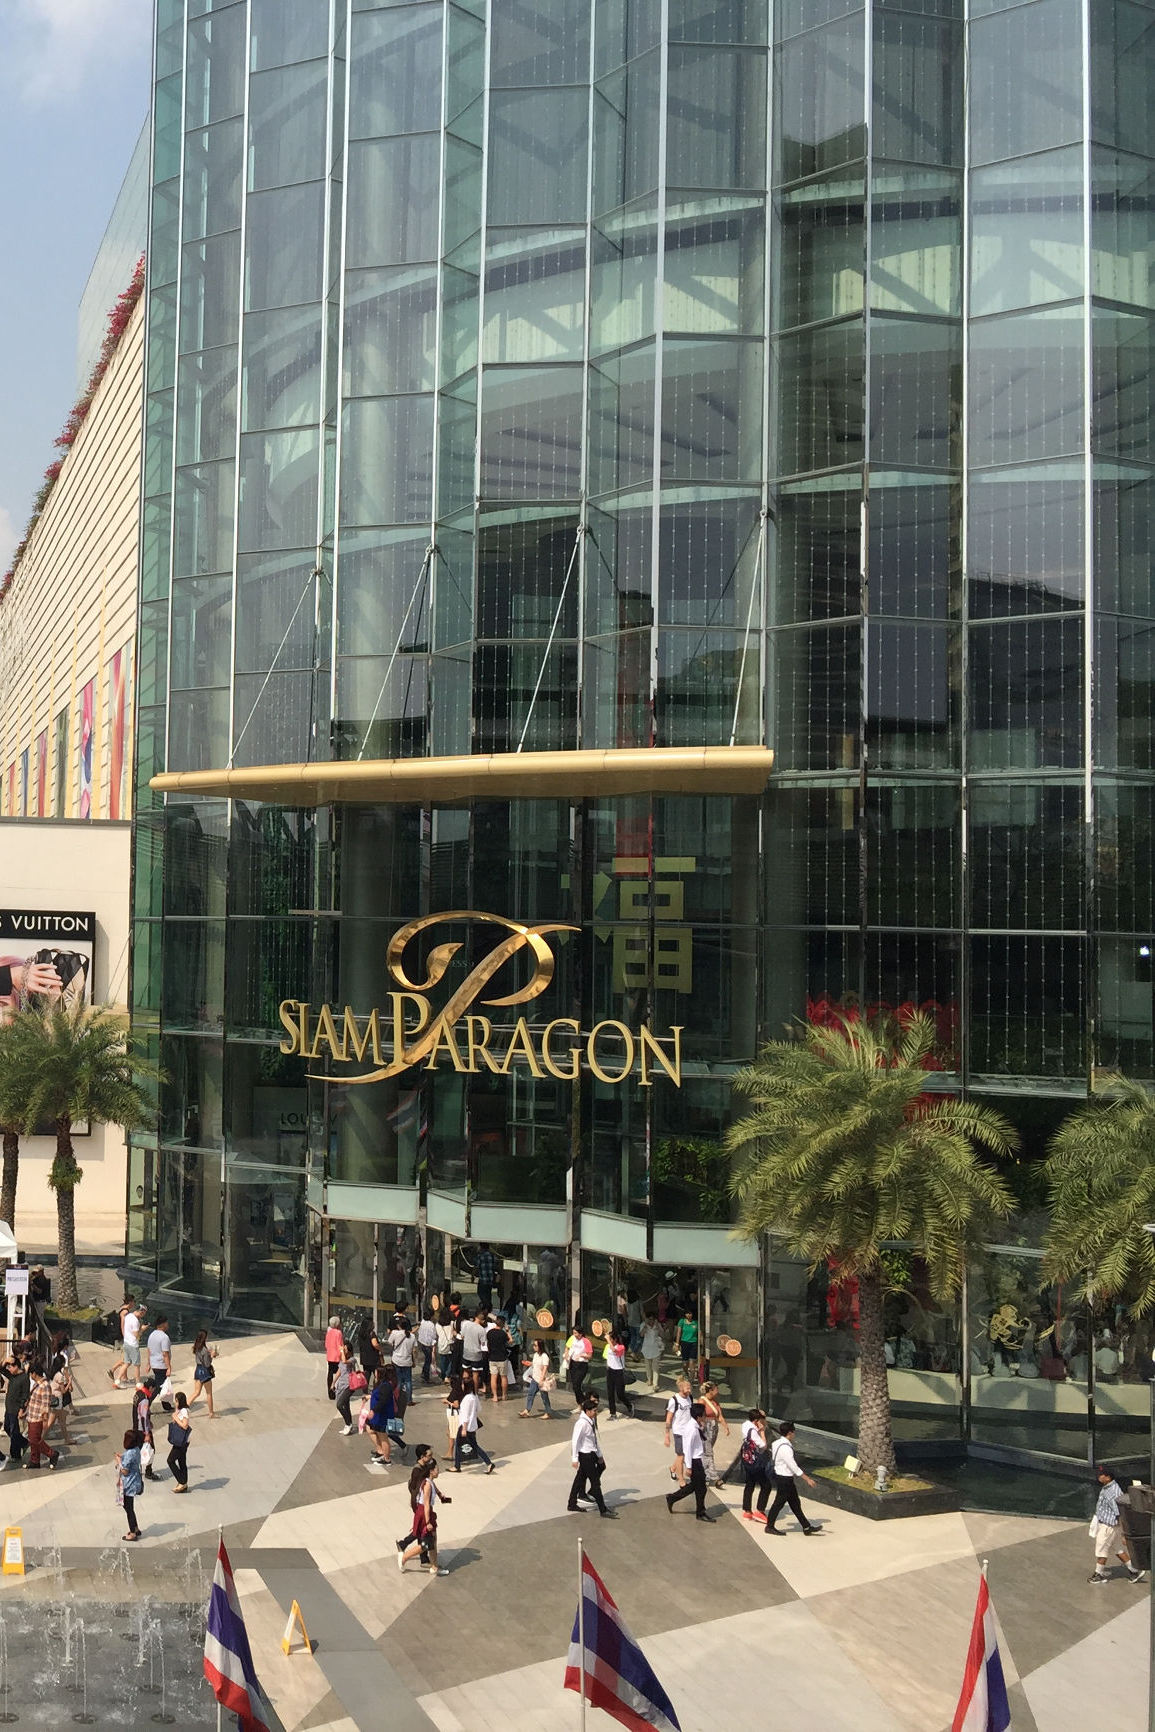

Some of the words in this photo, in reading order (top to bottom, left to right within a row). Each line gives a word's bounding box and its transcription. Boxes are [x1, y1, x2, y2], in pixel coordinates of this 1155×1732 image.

[11, 915, 89, 932] VUITTON
[279, 999, 387, 1066] SIAM
[386, 991, 685, 1089] PARAGON
